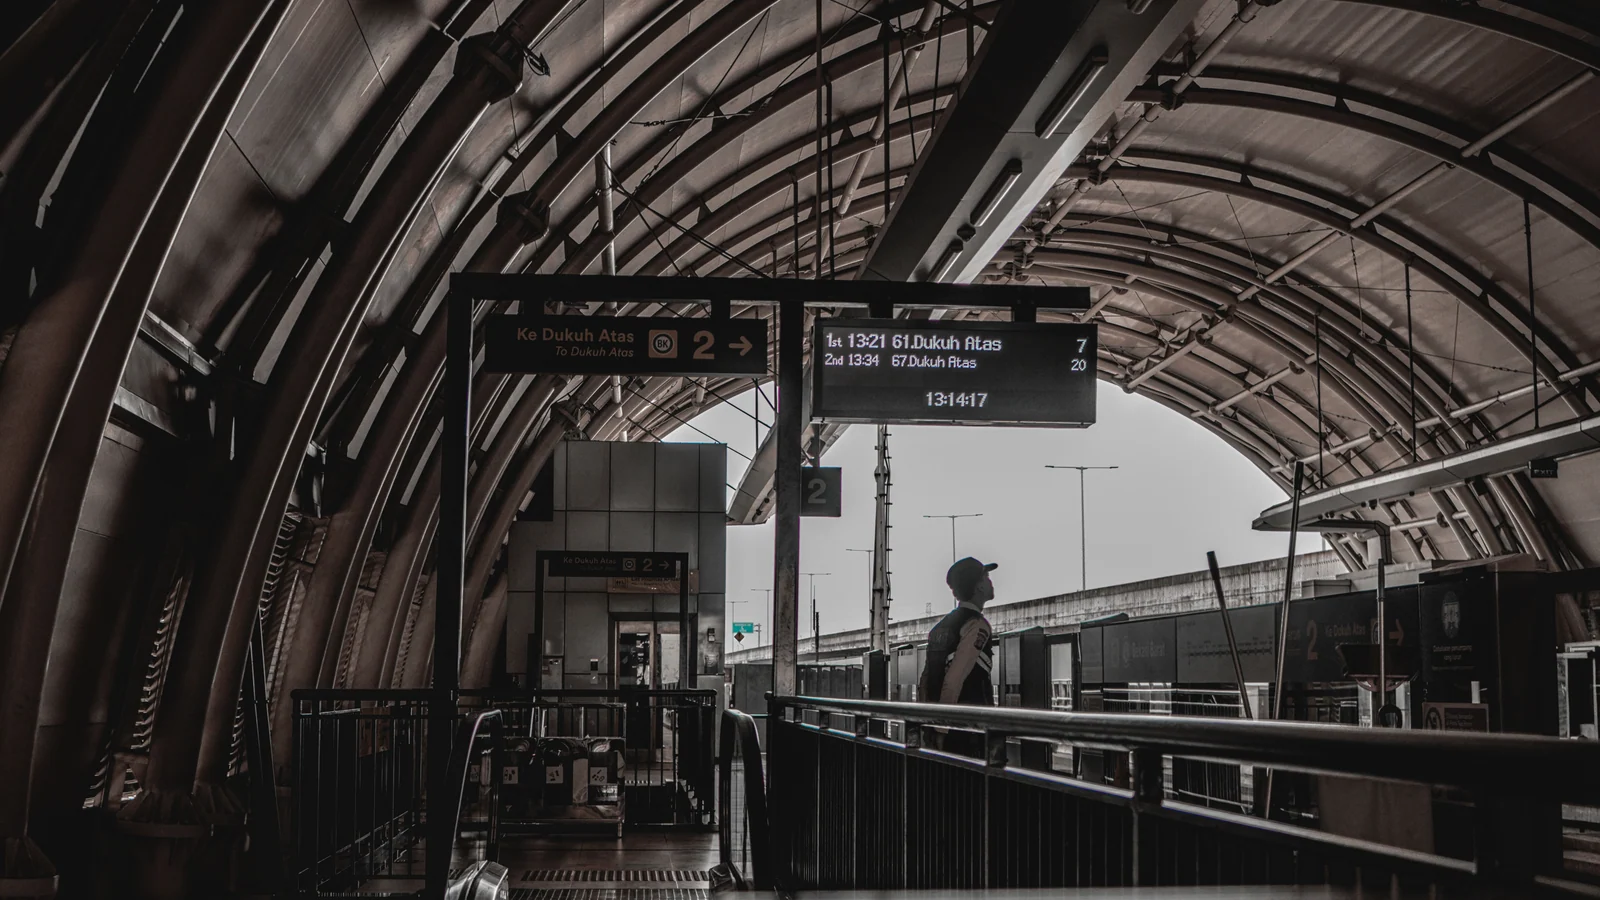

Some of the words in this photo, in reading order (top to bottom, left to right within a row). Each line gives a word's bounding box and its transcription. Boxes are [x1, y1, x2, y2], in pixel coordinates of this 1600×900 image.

[517, 327, 537, 341] Ke
[542, 328, 594, 343] Dukuh
[598, 329, 635, 344] Atas
[657, 338, 669, 349] BK
[826, 333, 842, 349] 1st
[848, 333, 886, 350] 13:21
[892, 334, 960, 351] 61.Dukuh
[964, 336, 1002, 352] Atas
[1076, 338, 1088, 354] 7
[555, 346, 568, 357] To
[570, 346, 606, 358] Dukuh
[608, 347, 634, 358] Atas
[692, 330, 716, 360] 2
[825, 354, 844, 367] 2nd
[848, 354, 880, 368] 13:34
[948, 356, 977, 370] Atas
[1071, 358, 1087, 372] 20
[925, 391, 988, 408] 13:14:17
[807, 478, 827, 504] 2
[563, 556, 573, 564] Ke
[600, 557, 617, 565] Atas
[642, 557, 653, 572] 2
[1306, 619, 1319, 660] 2
